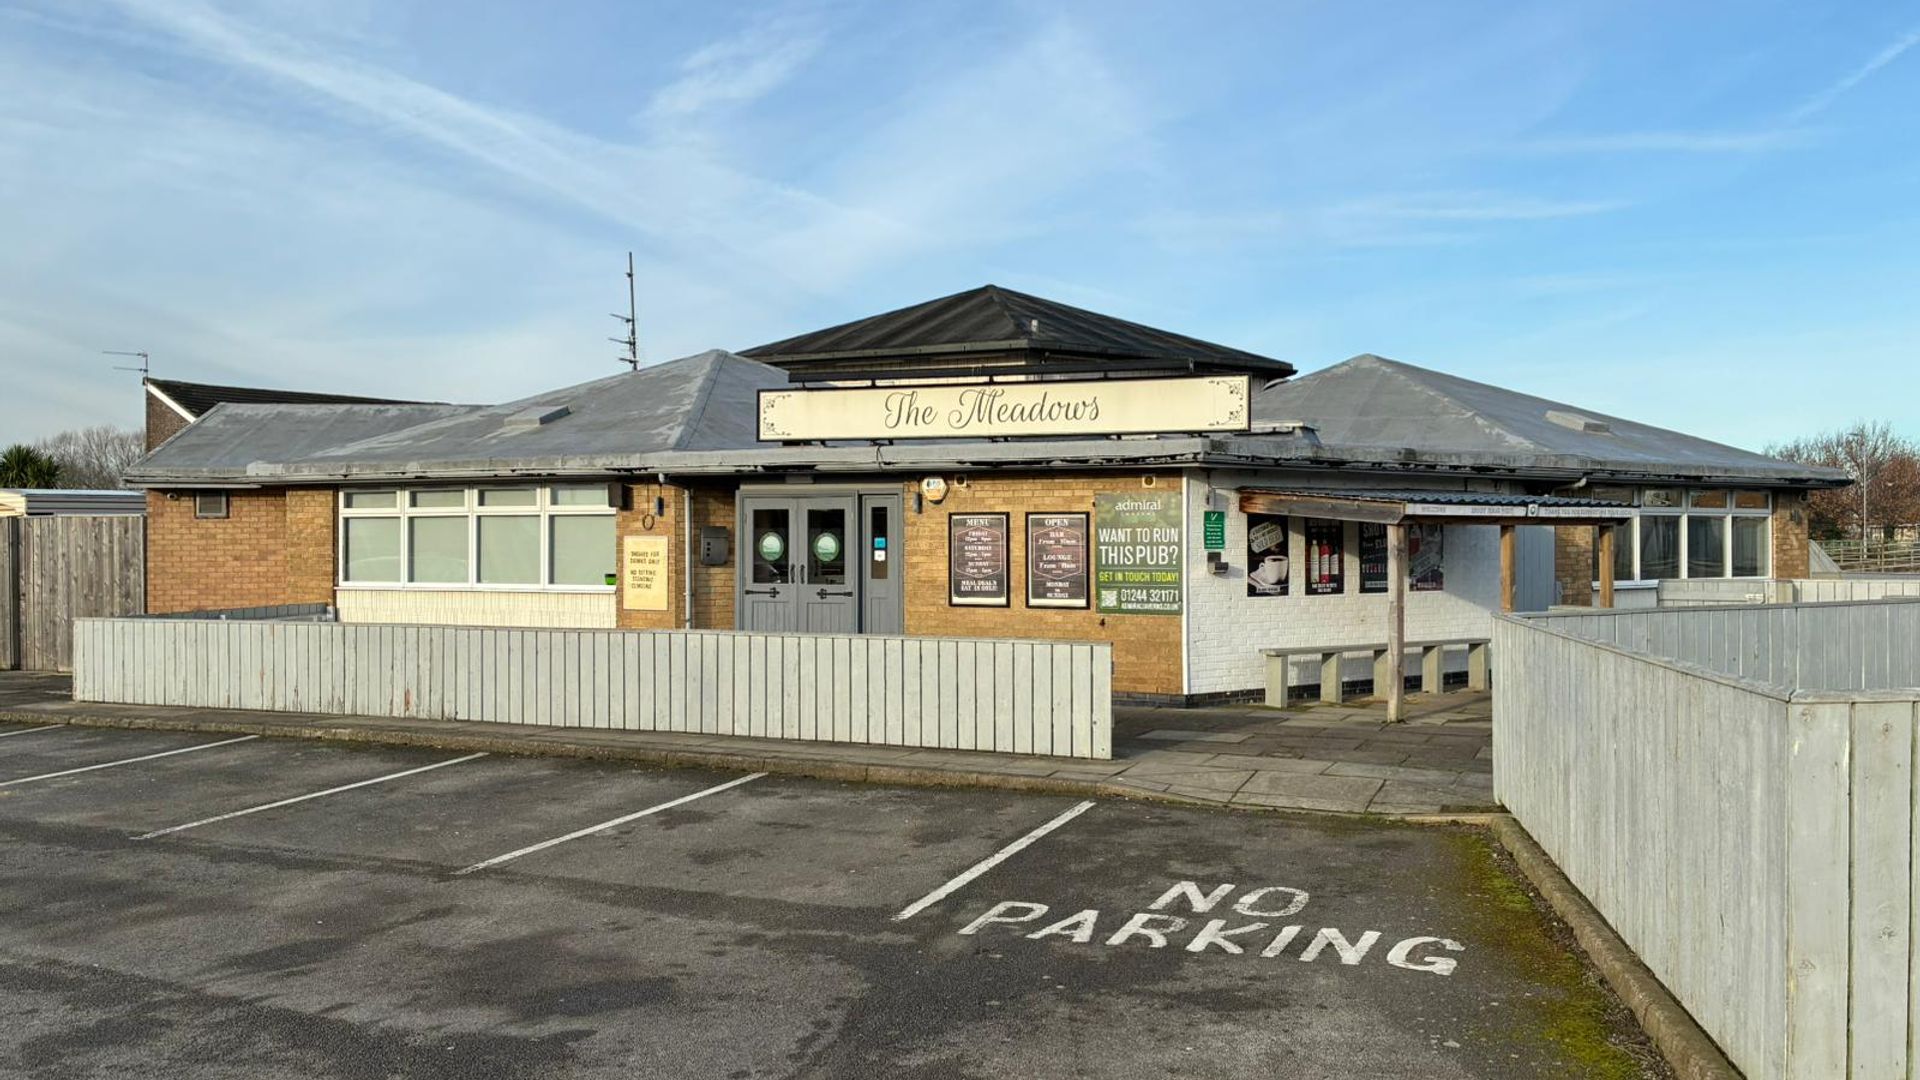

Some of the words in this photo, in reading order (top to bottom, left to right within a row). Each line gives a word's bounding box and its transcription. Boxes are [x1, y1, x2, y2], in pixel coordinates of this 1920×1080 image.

[885, 390, 938, 429] The
[948, 388, 1100, 430] Meadows
[1114, 499, 1161, 510] admiral
[1098, 528, 1132, 543] WANT
[1135, 528, 1150, 543] TO
[1153, 528, 1179, 543] RUN
[1099, 545, 1133, 565] THIS
[1136, 545, 1179, 565] PUB?
[1099, 571, 1113, 582] GET
[1114, 571, 1123, 582] IN
[1125, 572, 1150, 582] TOUCH
[1152, 572, 1179, 582] TODAY!
[1120, 589, 1147, 602] 01244
[1149, 589, 1179, 602] 321171
[1147, 881, 1310, 918] NO
[956, 900, 1466, 977] PARKING
